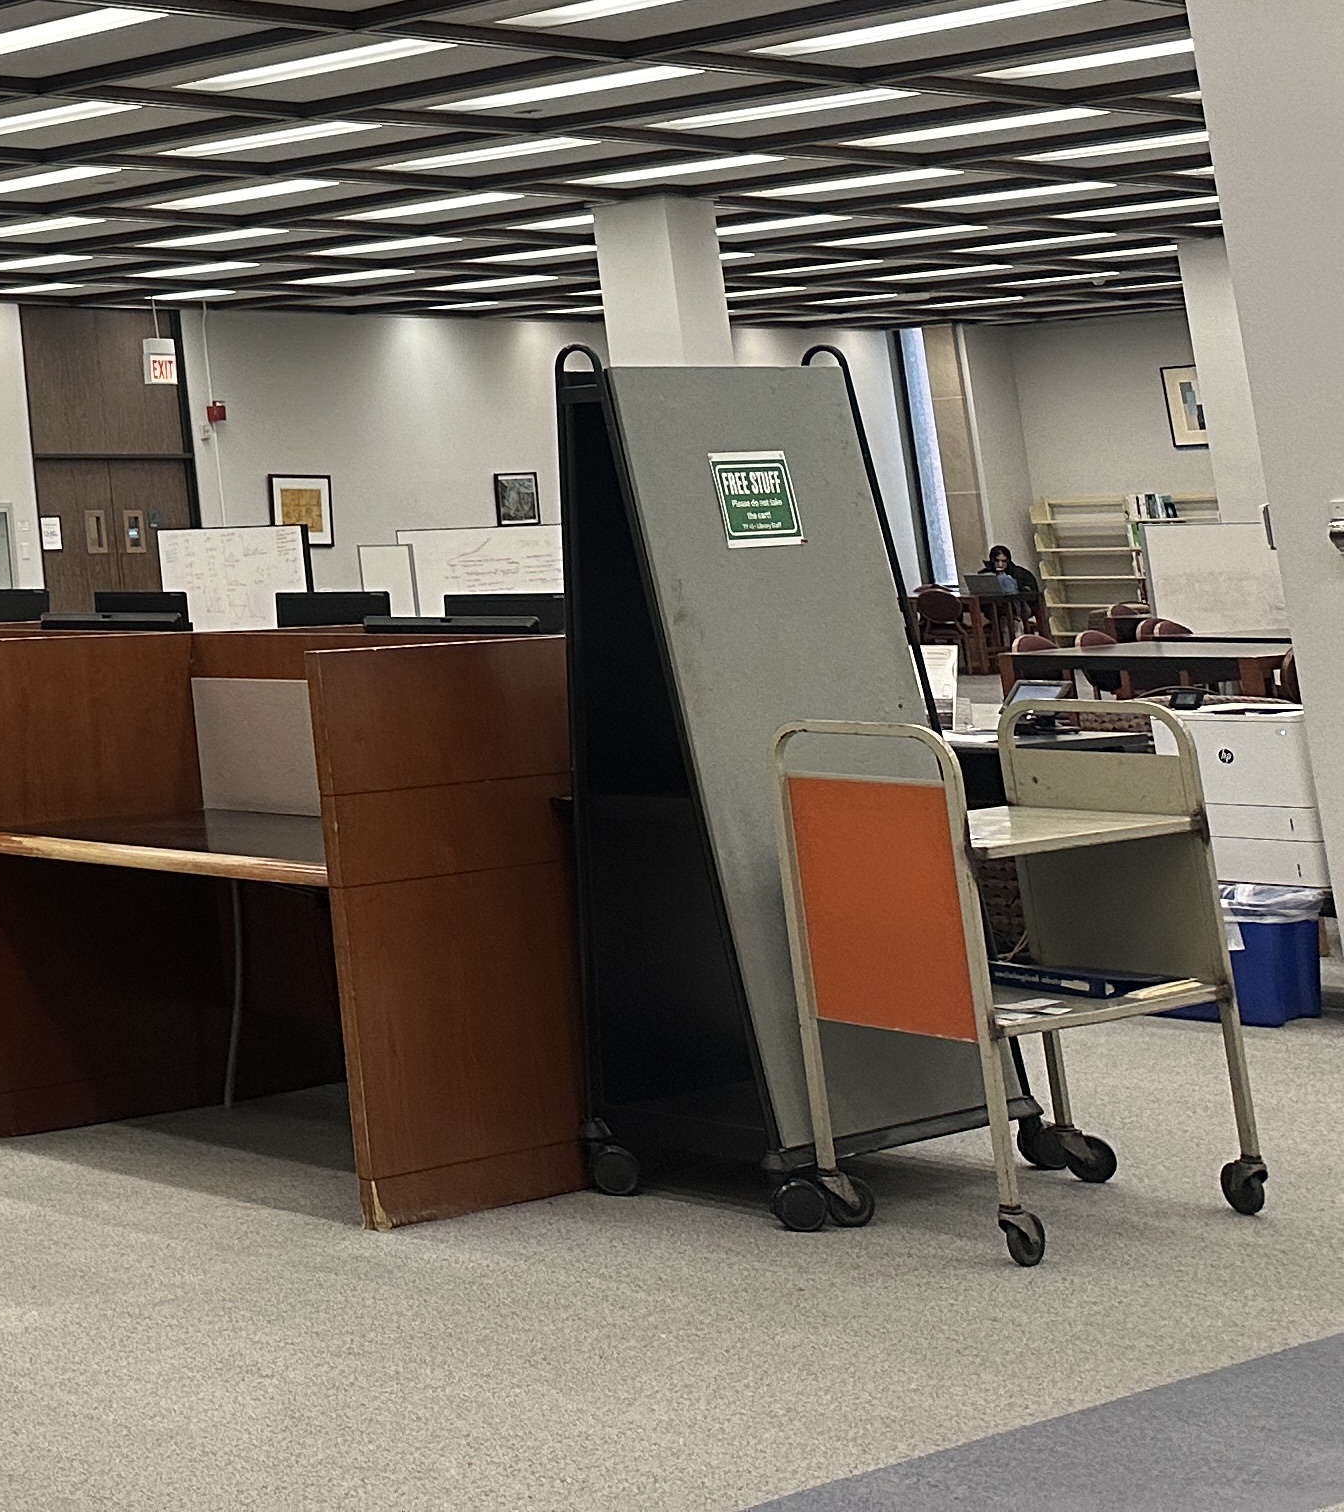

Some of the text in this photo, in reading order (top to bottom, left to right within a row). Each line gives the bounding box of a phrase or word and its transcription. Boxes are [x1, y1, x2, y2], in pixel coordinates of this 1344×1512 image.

[152, 359, 173, 379] EXIT
[721, 470, 781, 496] FREE STUFF
[731, 499, 751, 508] Please
[751, 499, 759, 507] do
[769, 498, 783, 506] take
[1221, 748, 1232, 764] hp
